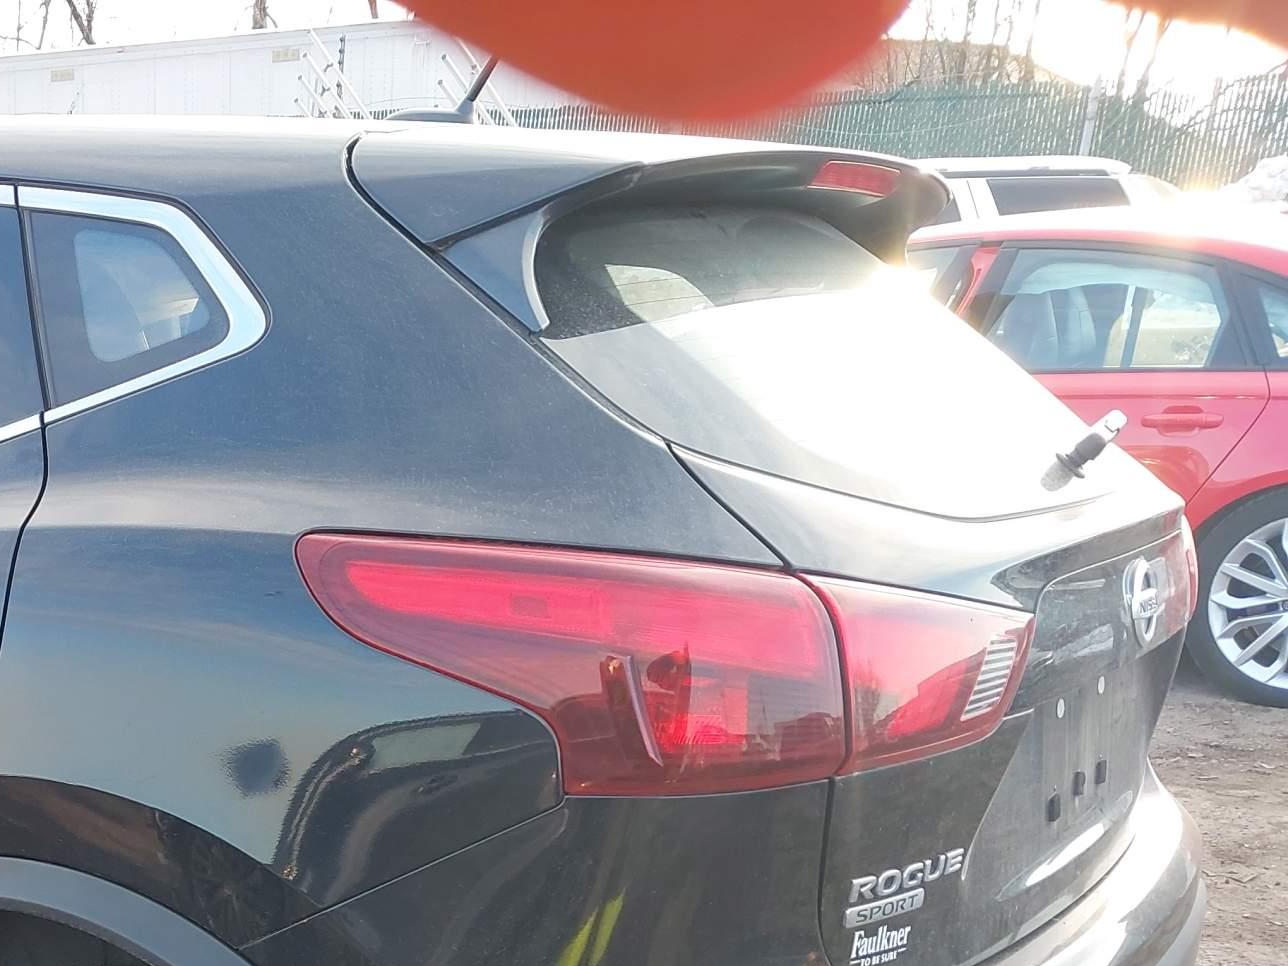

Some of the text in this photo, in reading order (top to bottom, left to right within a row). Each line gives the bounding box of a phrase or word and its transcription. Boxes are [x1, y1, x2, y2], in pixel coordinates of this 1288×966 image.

[849, 848, 965, 903] ROGUE
[855, 894, 919, 923] SPORT
[850, 925, 912, 959] Faulkner
